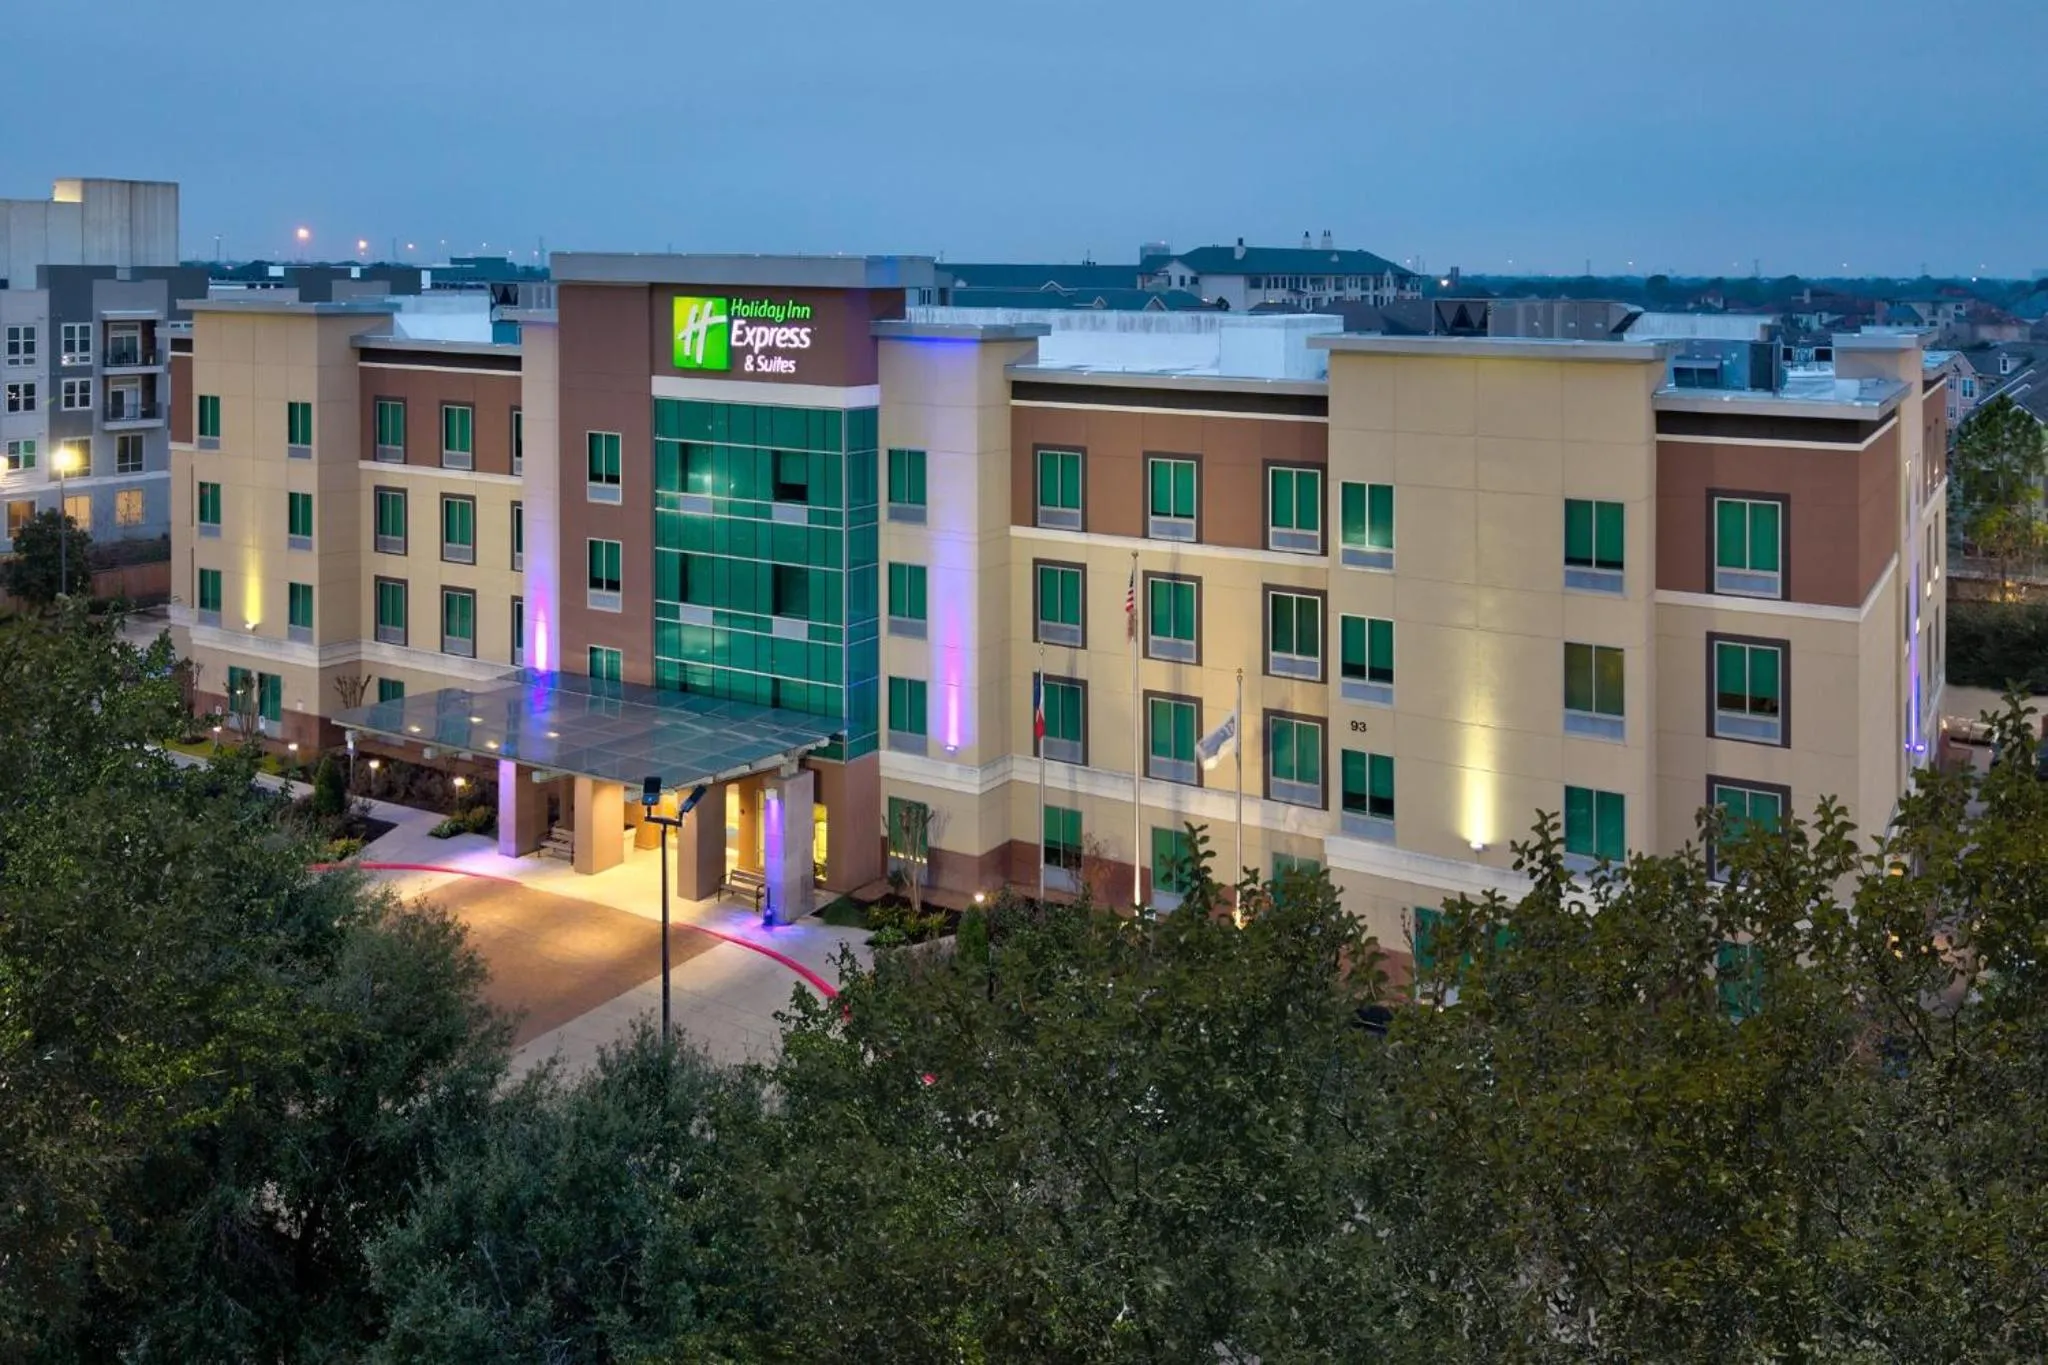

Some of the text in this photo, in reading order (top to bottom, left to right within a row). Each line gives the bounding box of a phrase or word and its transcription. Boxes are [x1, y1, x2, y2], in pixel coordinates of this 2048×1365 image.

[731, 298, 811, 323] Holiday Inn
[731, 319, 811, 354] Express
[744, 355, 796, 373] & Suites
[1351, 720, 1367, 732] 93
